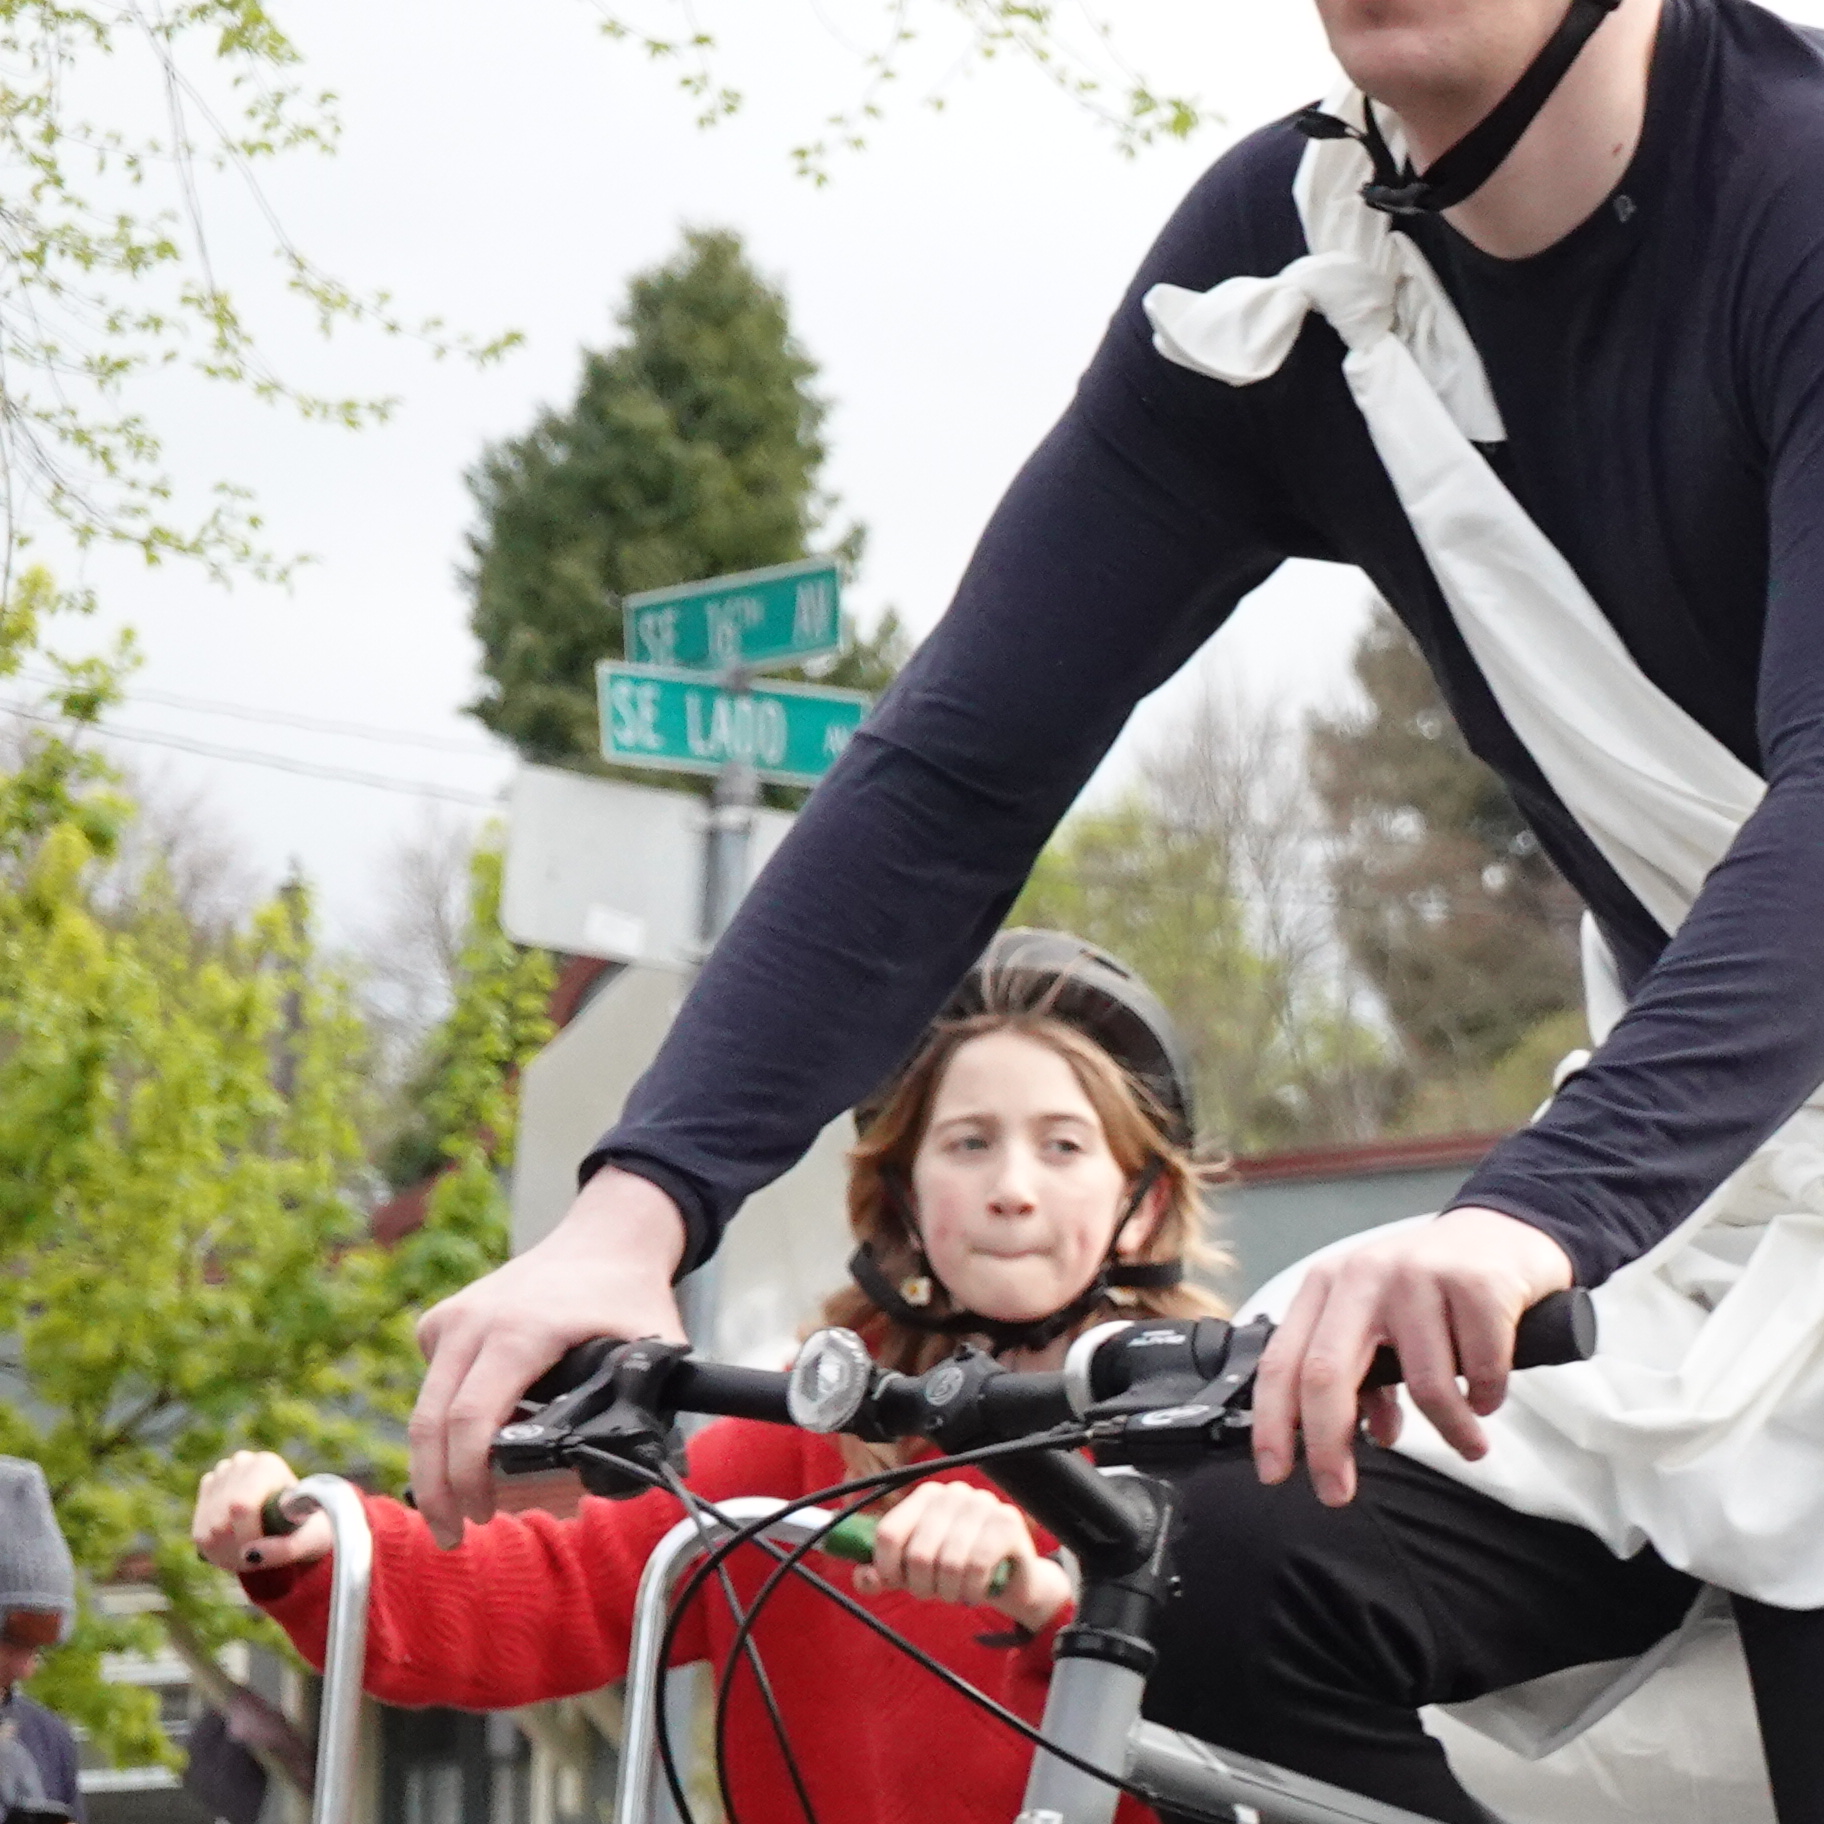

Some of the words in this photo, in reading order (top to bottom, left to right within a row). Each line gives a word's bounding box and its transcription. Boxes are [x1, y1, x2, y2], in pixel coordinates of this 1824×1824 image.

[637, 606, 679, 665] SE
[792, 578, 833, 648] AV
[609, 679, 665, 751] SE
[686, 688, 790, 766] LADD
